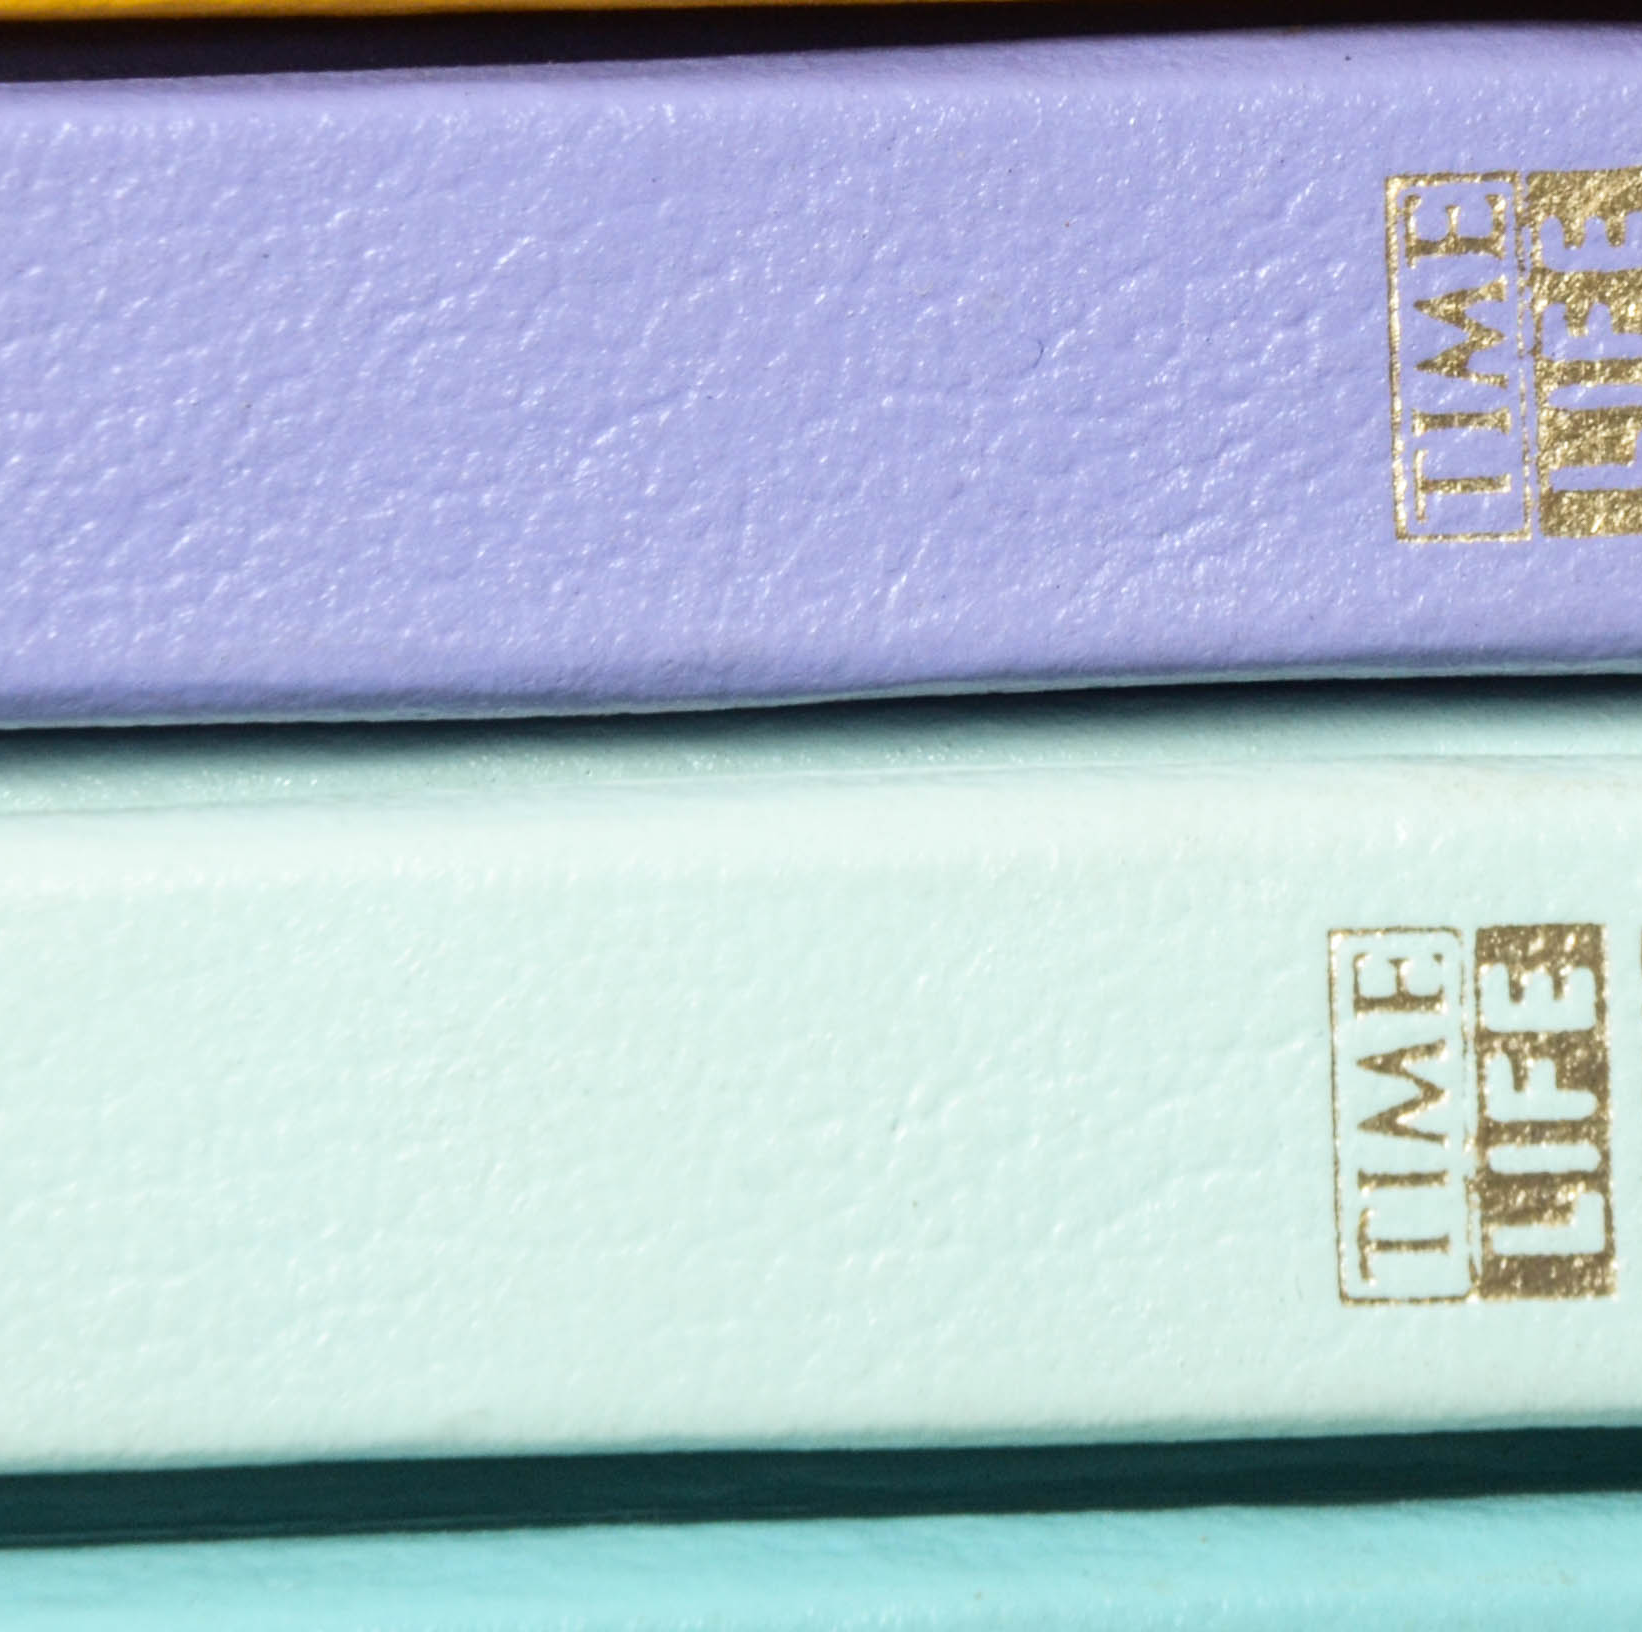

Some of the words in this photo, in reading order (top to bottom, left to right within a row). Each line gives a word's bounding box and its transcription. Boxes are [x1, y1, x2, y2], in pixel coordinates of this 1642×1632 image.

[1404, 194, 1512, 523] TIME
[1354, 952, 1450, 1286] TIME
[1481, 963, 1607, 1256] LIFE
